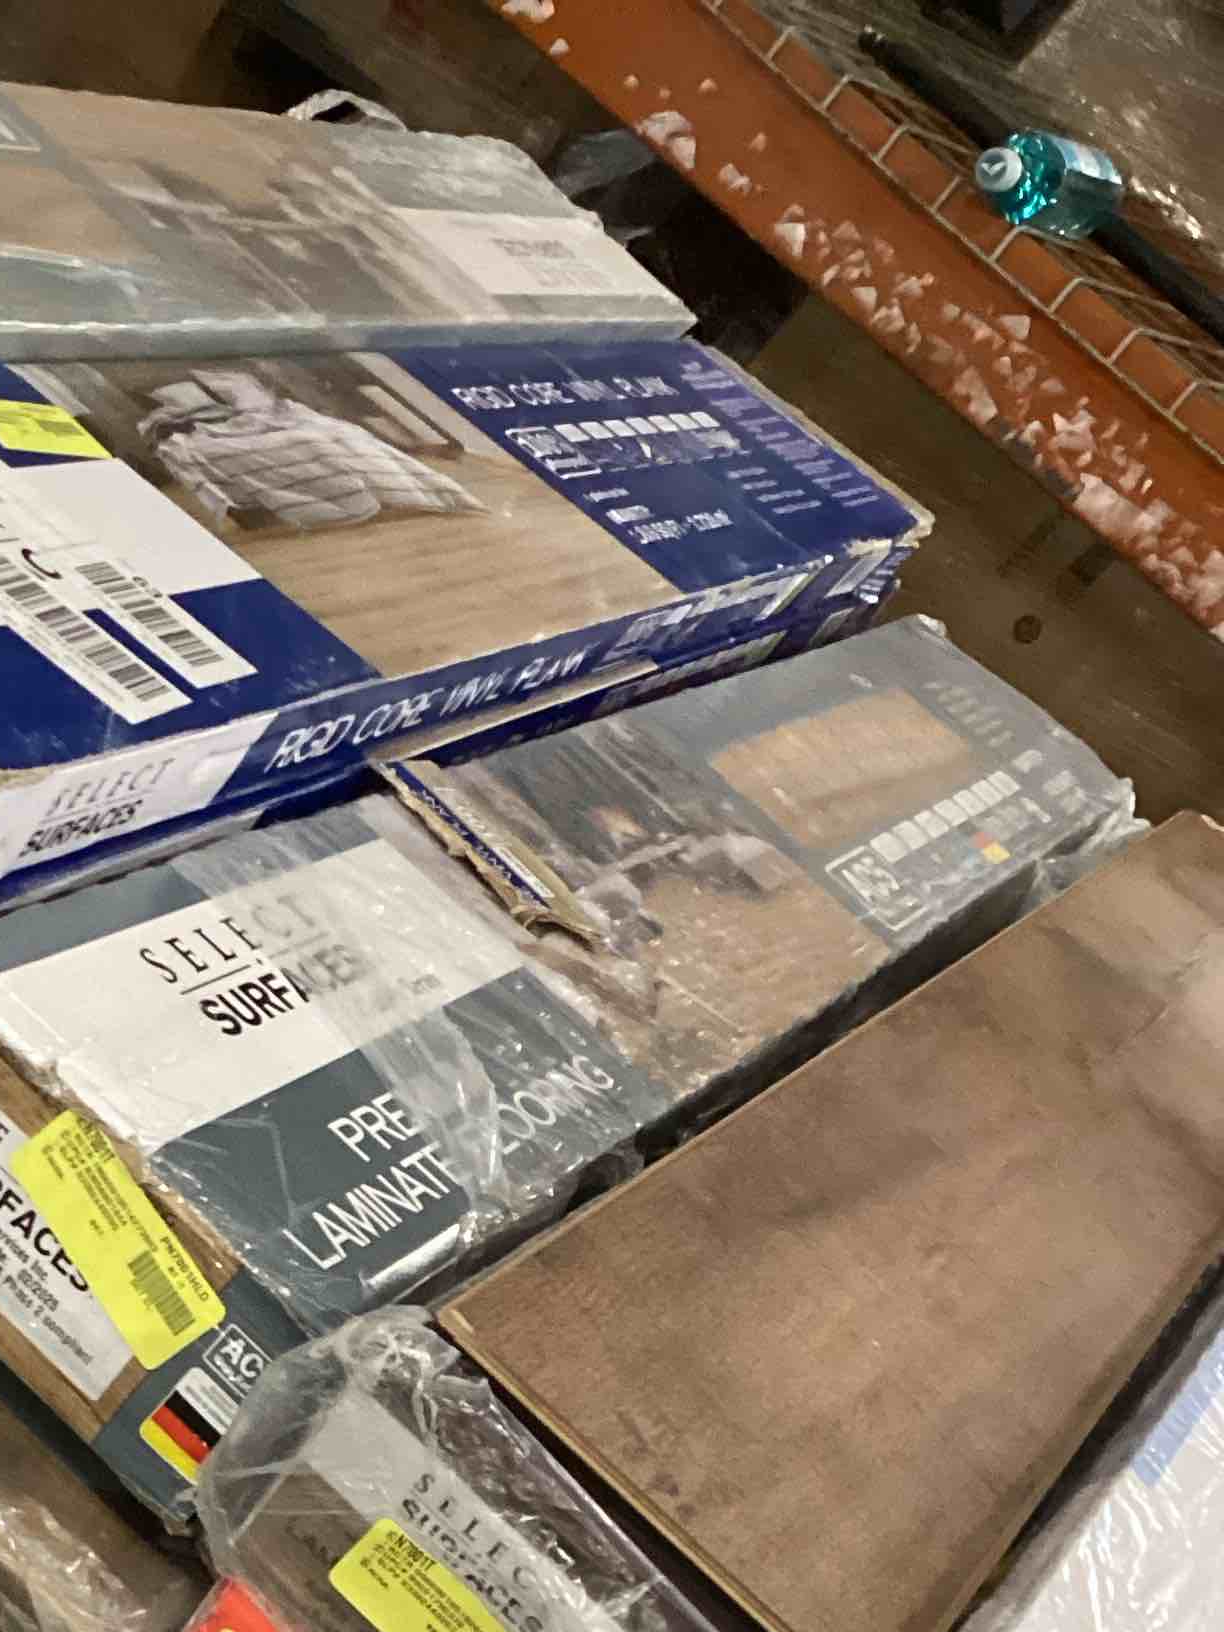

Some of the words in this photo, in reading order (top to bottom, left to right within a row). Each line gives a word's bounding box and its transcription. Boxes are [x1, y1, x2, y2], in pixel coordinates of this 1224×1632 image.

[47, 754, 174, 820] SELECT
[18, 801, 142, 859] SURFACES
[221, 1343, 266, 1382] AC
